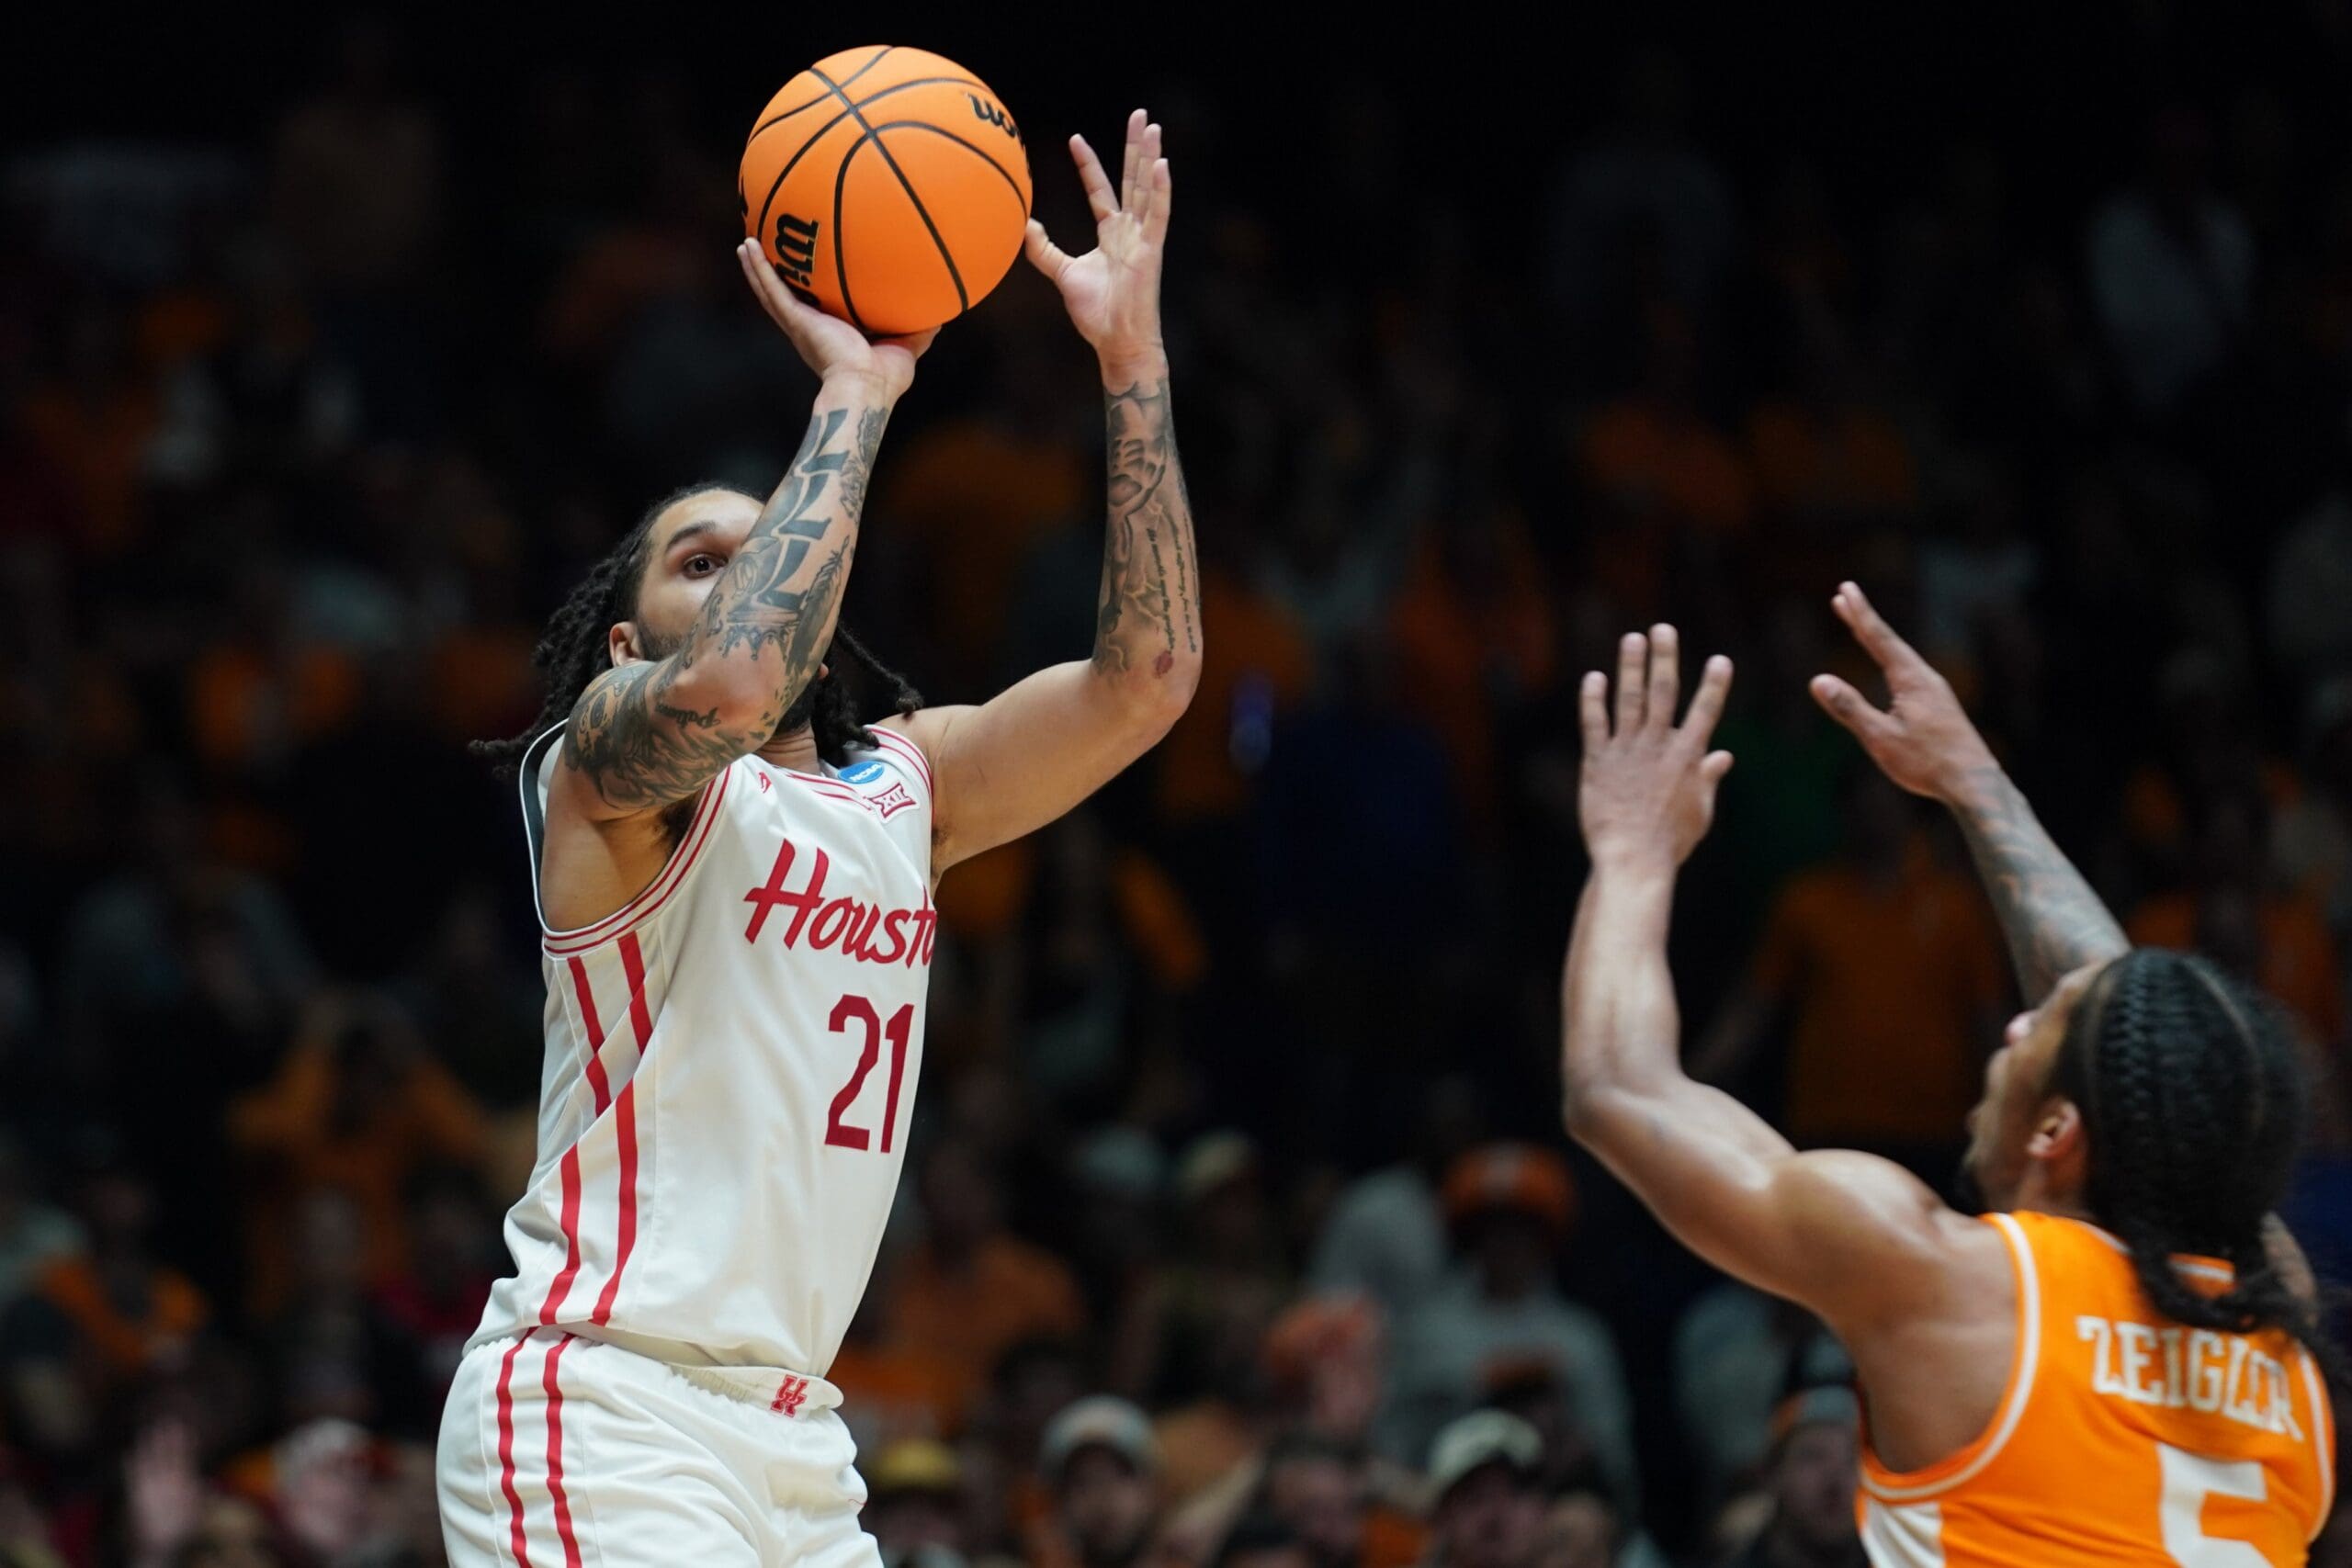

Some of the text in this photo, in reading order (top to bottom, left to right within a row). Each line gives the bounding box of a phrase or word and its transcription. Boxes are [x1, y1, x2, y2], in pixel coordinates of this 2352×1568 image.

[848, 762, 883, 783] NCAA
[824, 993, 915, 1154] 21
[2156, 1440, 2277, 1568] 5
